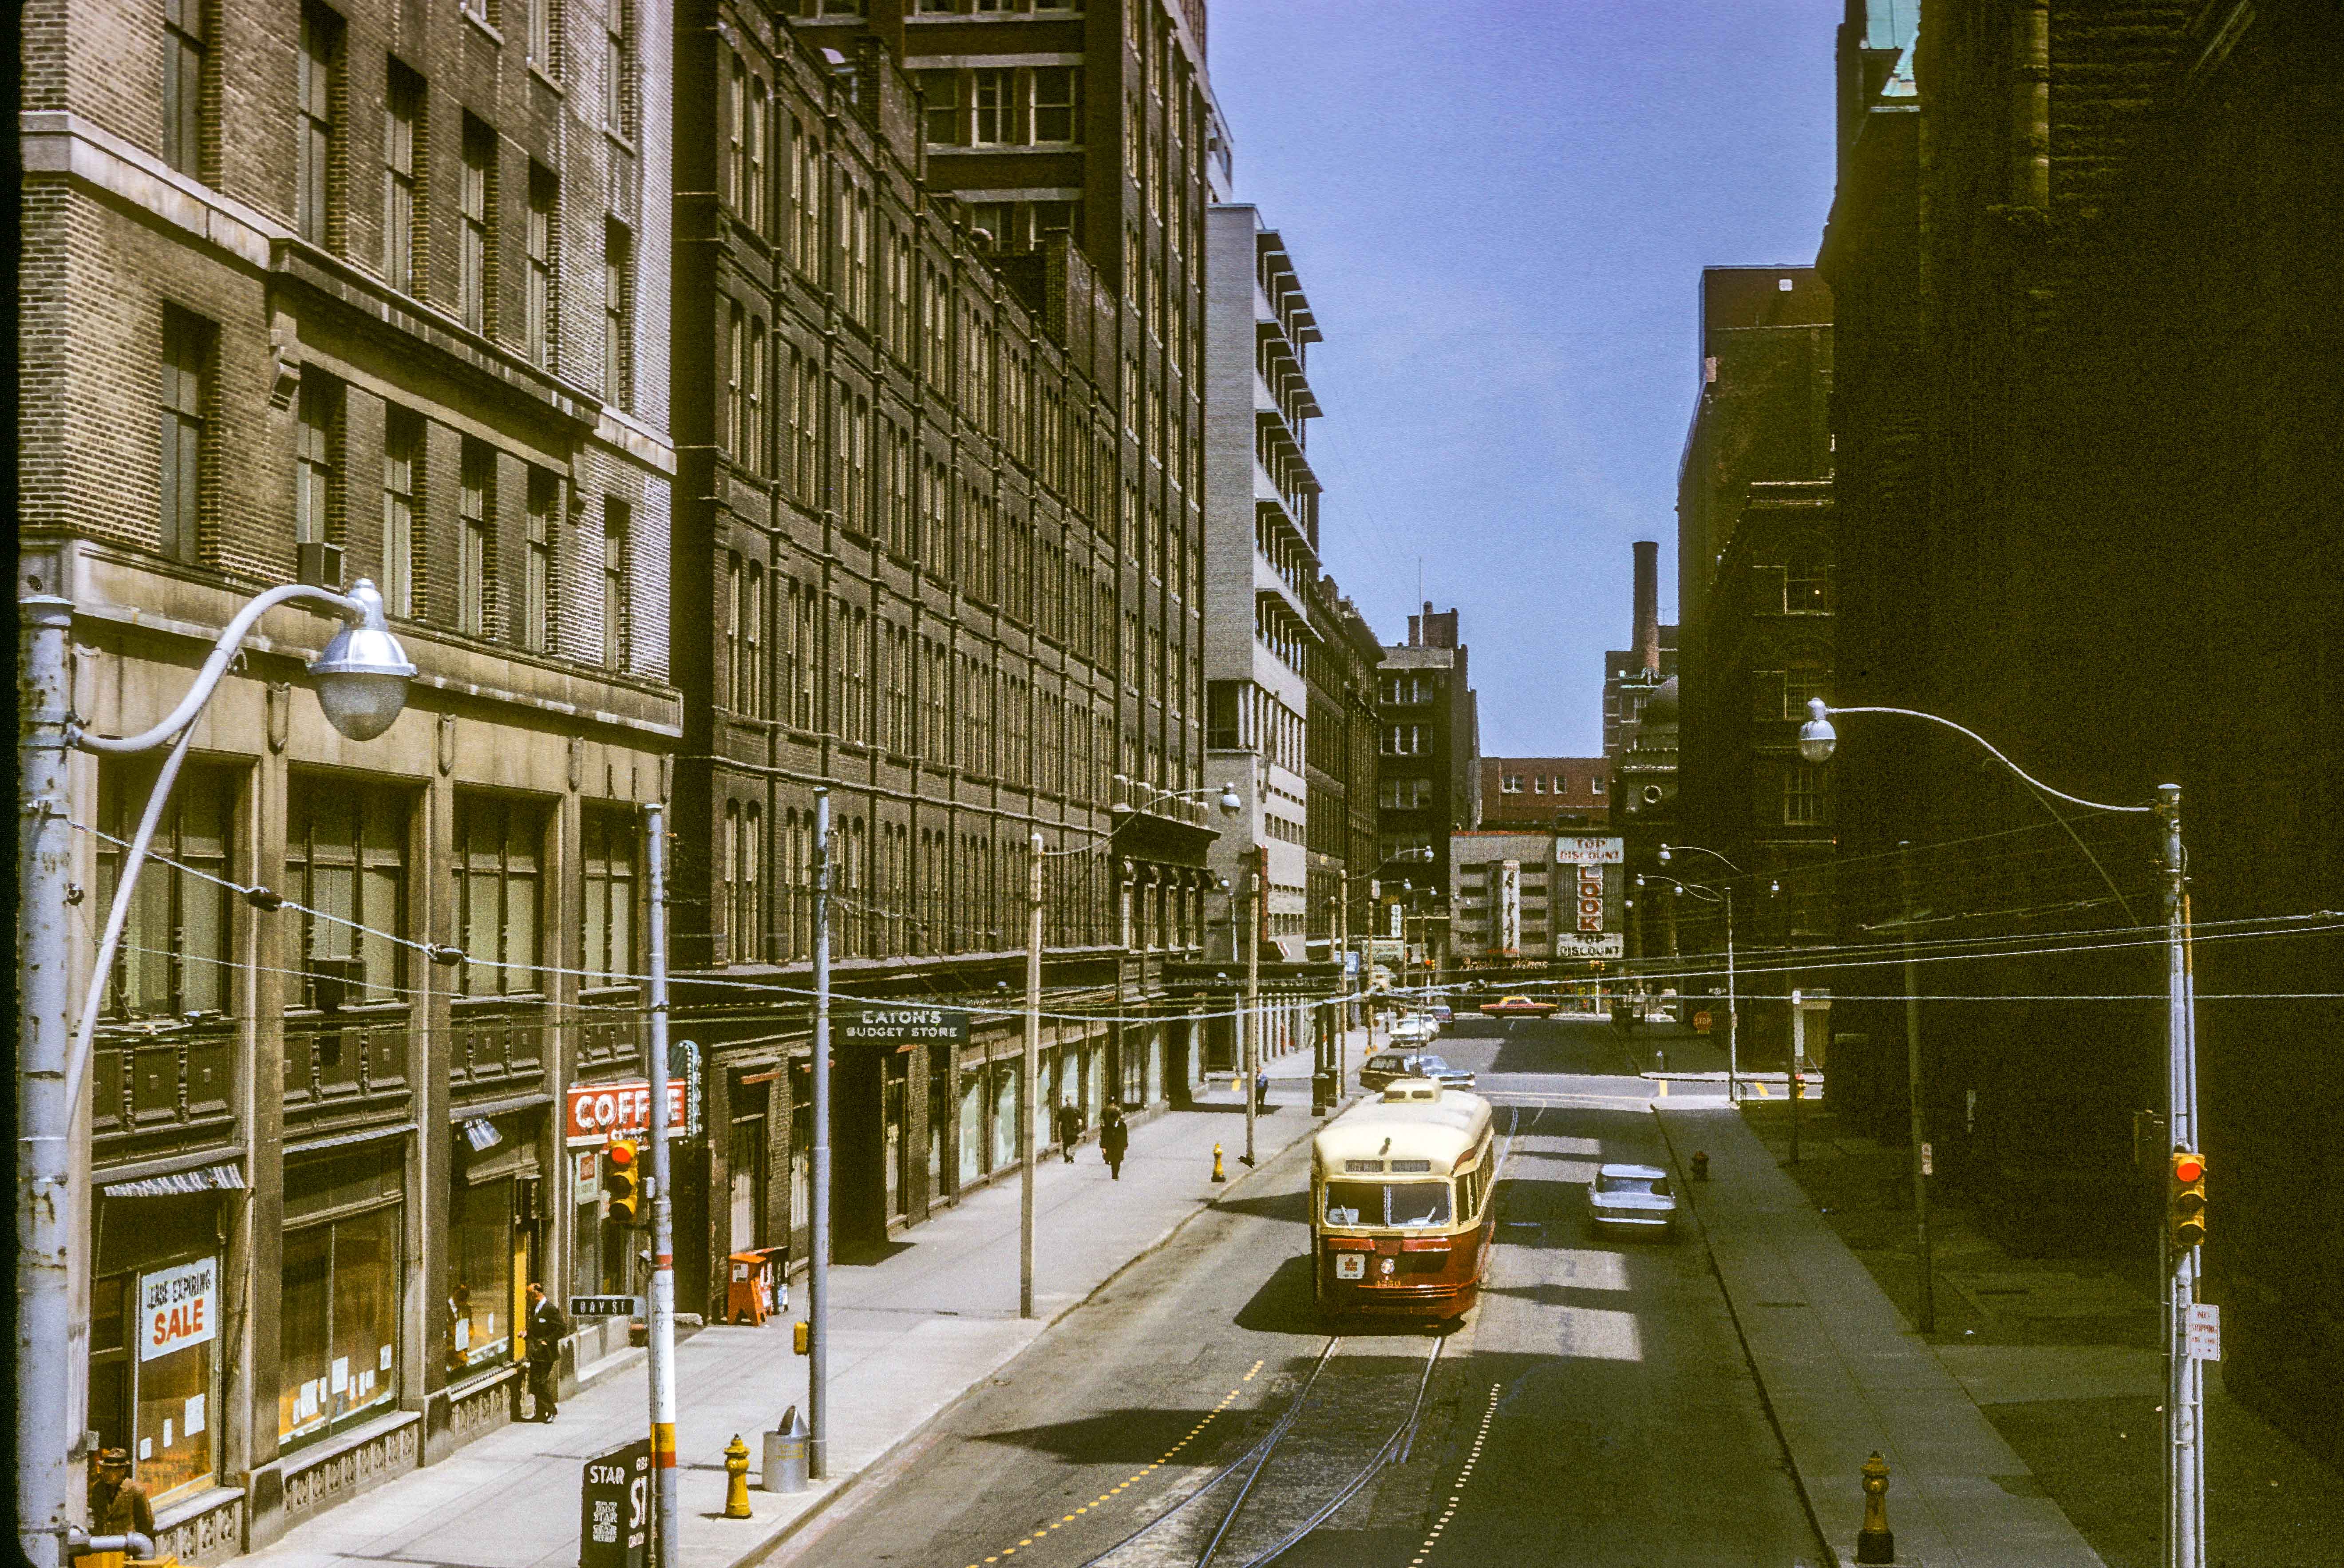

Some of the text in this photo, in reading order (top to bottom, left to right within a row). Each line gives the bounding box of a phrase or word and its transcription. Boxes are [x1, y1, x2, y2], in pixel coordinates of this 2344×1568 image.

[1577, 839, 1606, 849] TOP
[1560, 851, 1620, 860] DISCOUNT
[1580, 866, 1599, 930] LOOK
[1574, 934, 1605, 945] TOP
[1559, 946, 1620, 956] DISCOUNT
[862, 1010, 942, 1024] EATON'S
[846, 1027, 957, 1038] BUDGET STORE
[575, 1088, 683, 1128] COFFE
[580, 1301, 604, 1313] BAY
[153, 1298, 203, 1345] SALE
[589, 1465, 625, 1484] STAR
[593, 1512, 617, 1523] STAR
